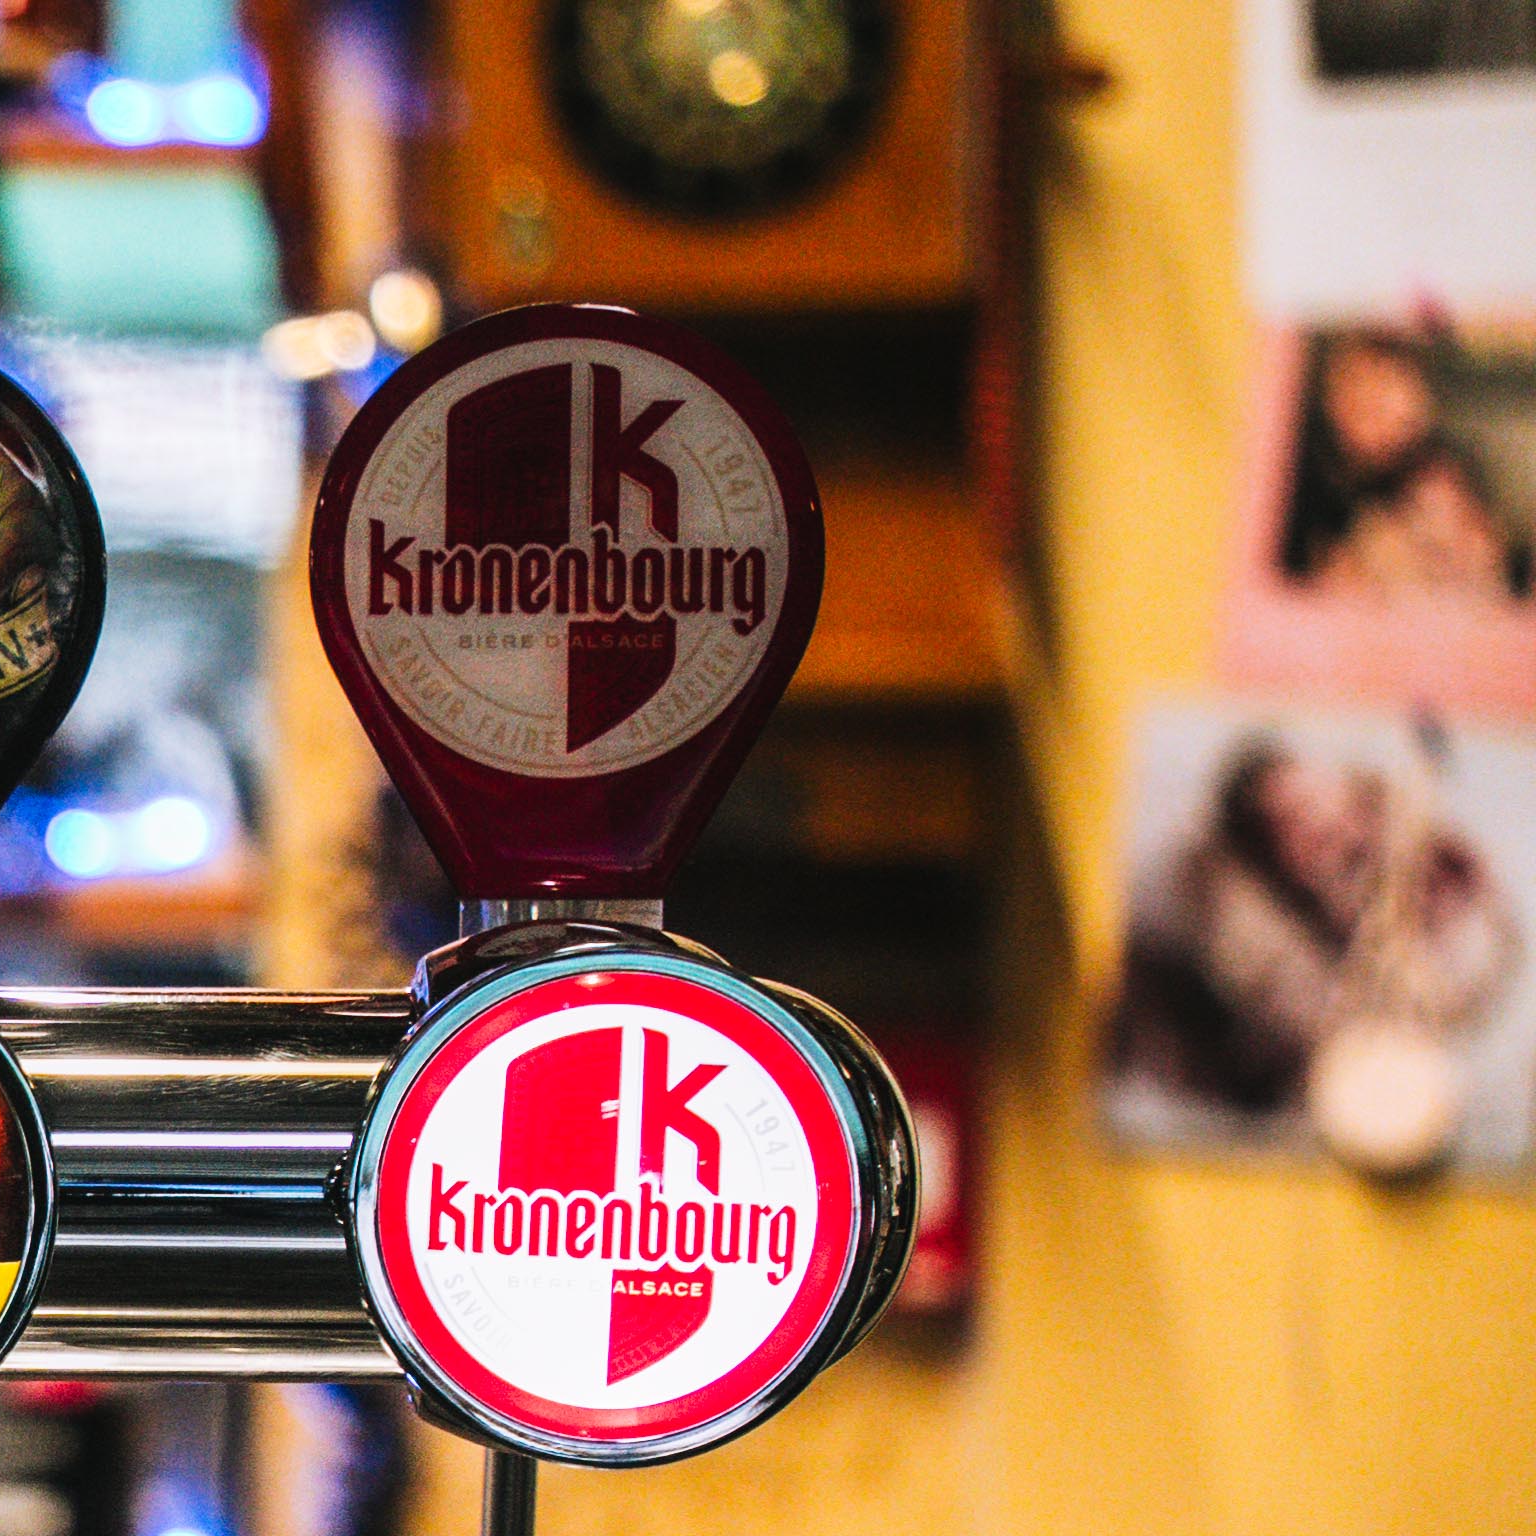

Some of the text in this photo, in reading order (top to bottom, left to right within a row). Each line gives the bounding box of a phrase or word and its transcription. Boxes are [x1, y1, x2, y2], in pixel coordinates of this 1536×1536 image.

[368, 518, 767, 635] Kronenbourg
[458, 630, 666, 649] BIÈRE D'ALSACE
[744, 1096, 796, 1173] 1947
[427, 1162, 798, 1286] Kronenbourg
